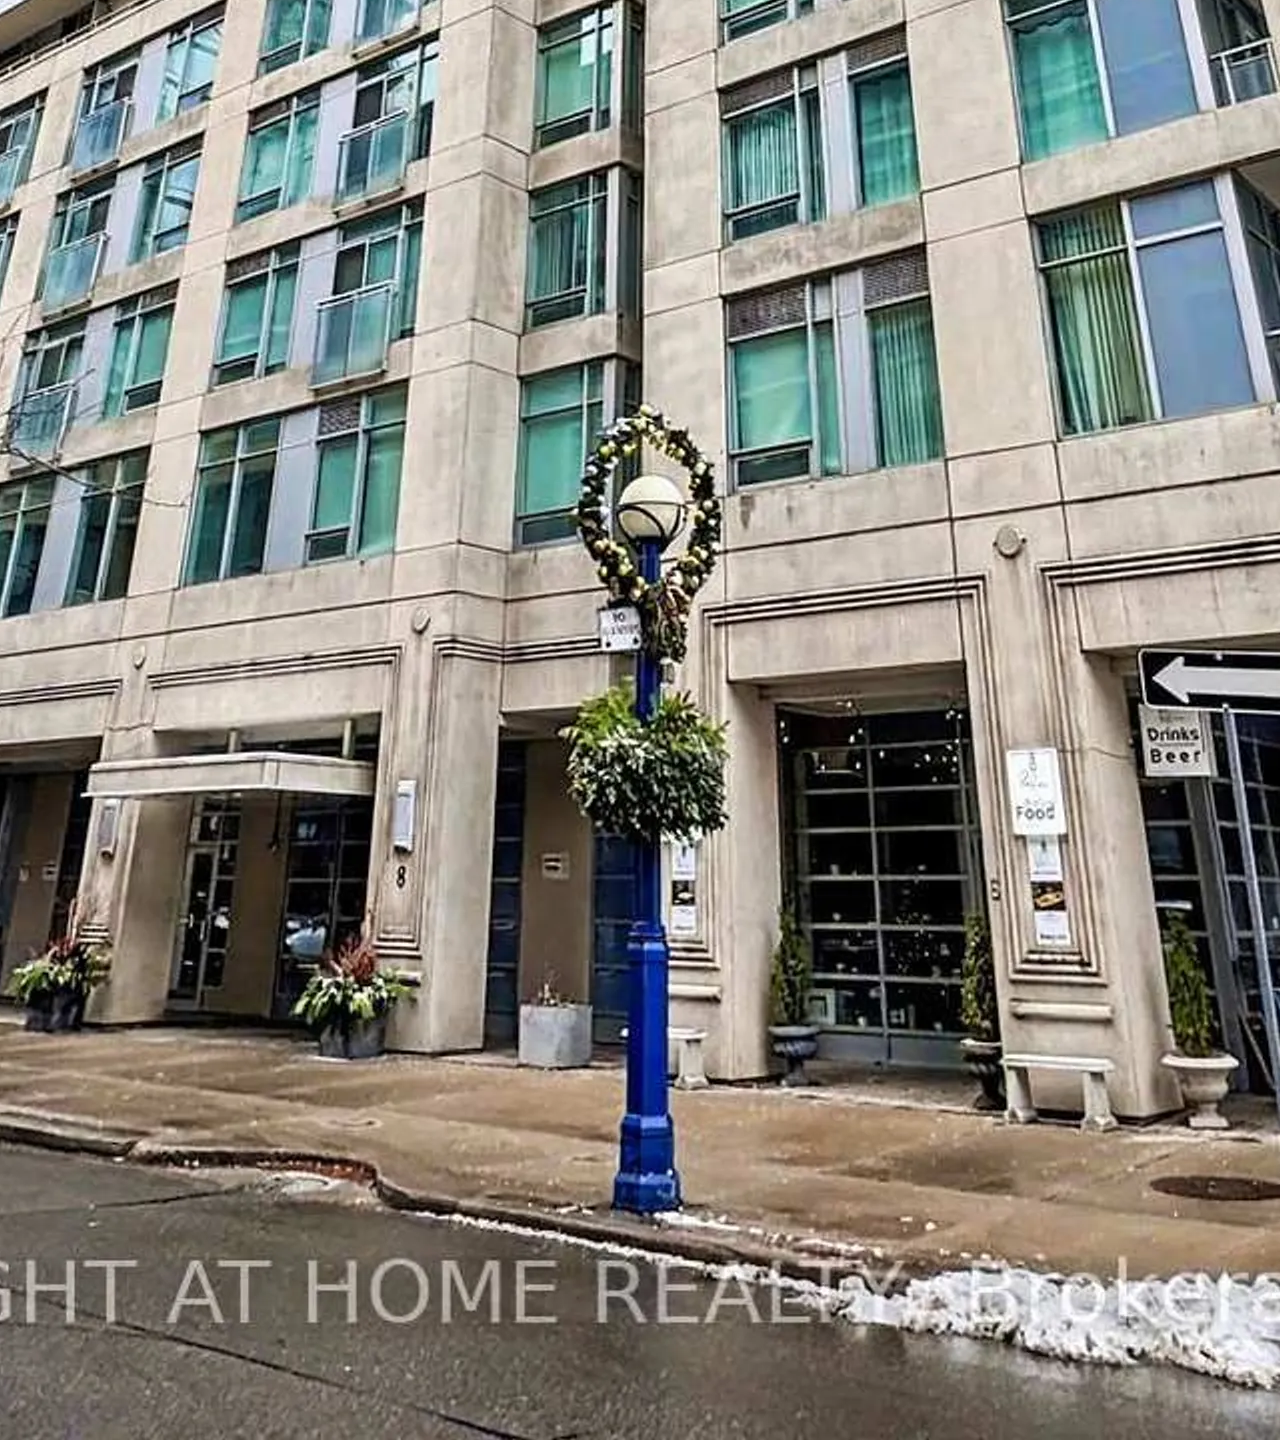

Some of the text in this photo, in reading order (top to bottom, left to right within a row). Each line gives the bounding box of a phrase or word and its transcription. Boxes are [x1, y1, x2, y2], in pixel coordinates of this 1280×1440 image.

[1147, 727, 1200, 741] Drinks
[1150, 748, 1201, 763] Beer
[1016, 803, 1055, 820] Food
[396, 865, 406, 889] 8
